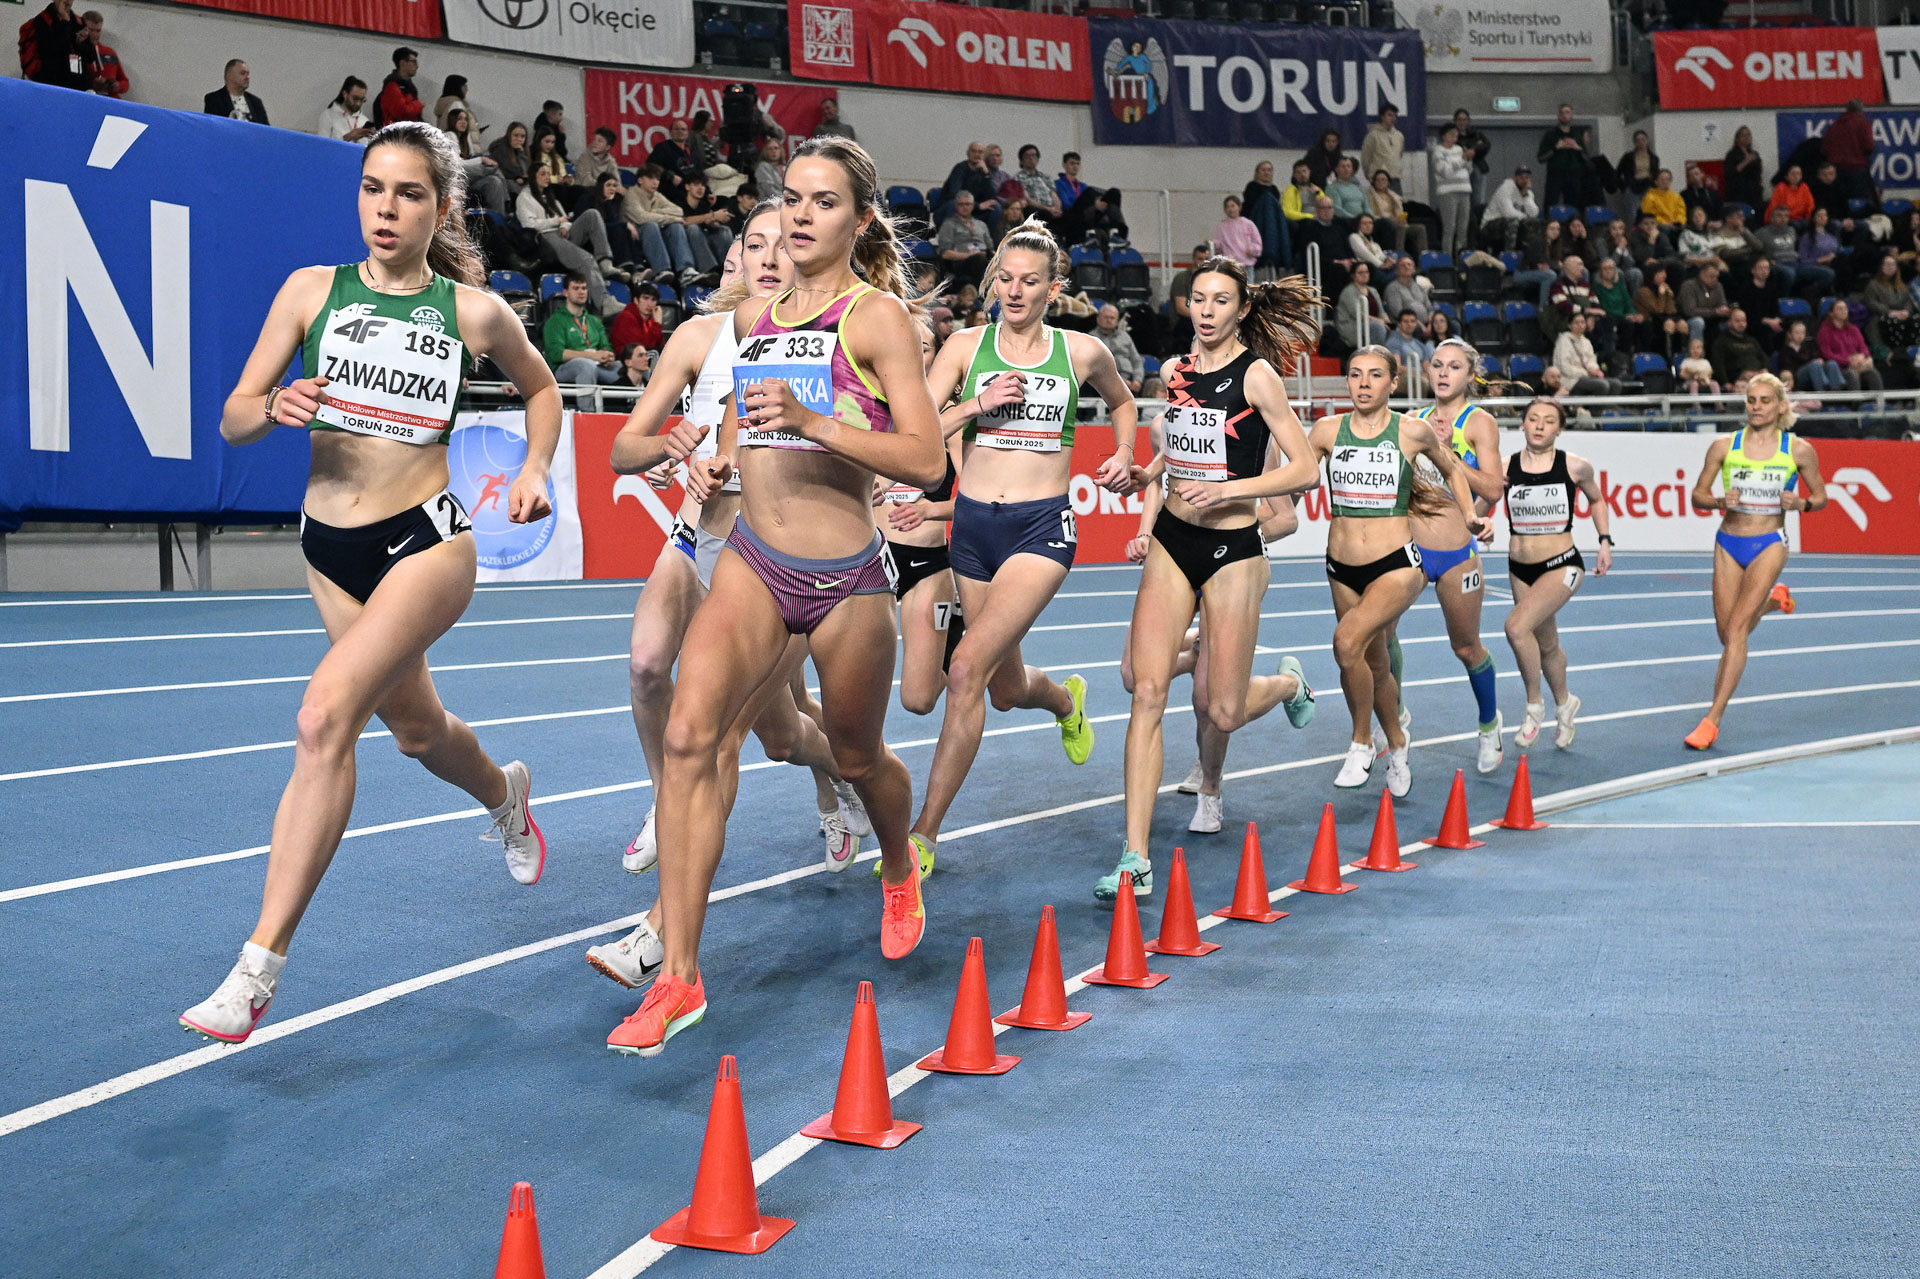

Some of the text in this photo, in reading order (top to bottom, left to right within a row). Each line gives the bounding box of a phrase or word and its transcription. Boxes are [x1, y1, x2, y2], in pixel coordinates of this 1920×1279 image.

[569, 1, 656, 32] Okęcie
[1468, 10, 1561, 26] Ministerstwo
[1469, 29, 1593, 47] Sportu i Turystyki
[805, 43, 851, 63] PZLA
[956, 31, 1072, 72] ORLEN
[1744, 50, 1864, 81] ORLEN
[1173, 42, 1408, 117] TORUŃ
[24, 114, 192, 460] Ń
[333, 318, 451, 360] 4F 185
[740, 336, 825, 362] 4F 333
[325, 355, 447, 404] ZAWADZKA
[1034, 376, 1057, 391] 79
[347, 403, 376, 415] Halowe
[377, 410, 422, 425] Mistrzostwa
[422, 418, 445, 428] Polski
[1164, 406, 1217, 427] 4F 135
[342, 415, 414, 438] TORUŃ 2025
[995, 438, 1044, 448] TORUŃ 2025
[1166, 433, 1216, 454] KRÓLIK
[1335, 449, 1393, 463] 4F 151
[1332, 470, 1395, 488] CHORZĘPA
[1733, 470, 1780, 481] 4F 314
[1511, 488, 1558, 500] 4F 70
[1511, 504, 1566, 518] SZYMANOWICZ
[1546, 548, 1576, 568] NIKE PRO
[1464, 572, 1480, 589] 10
[938, 604, 948, 628] 7
